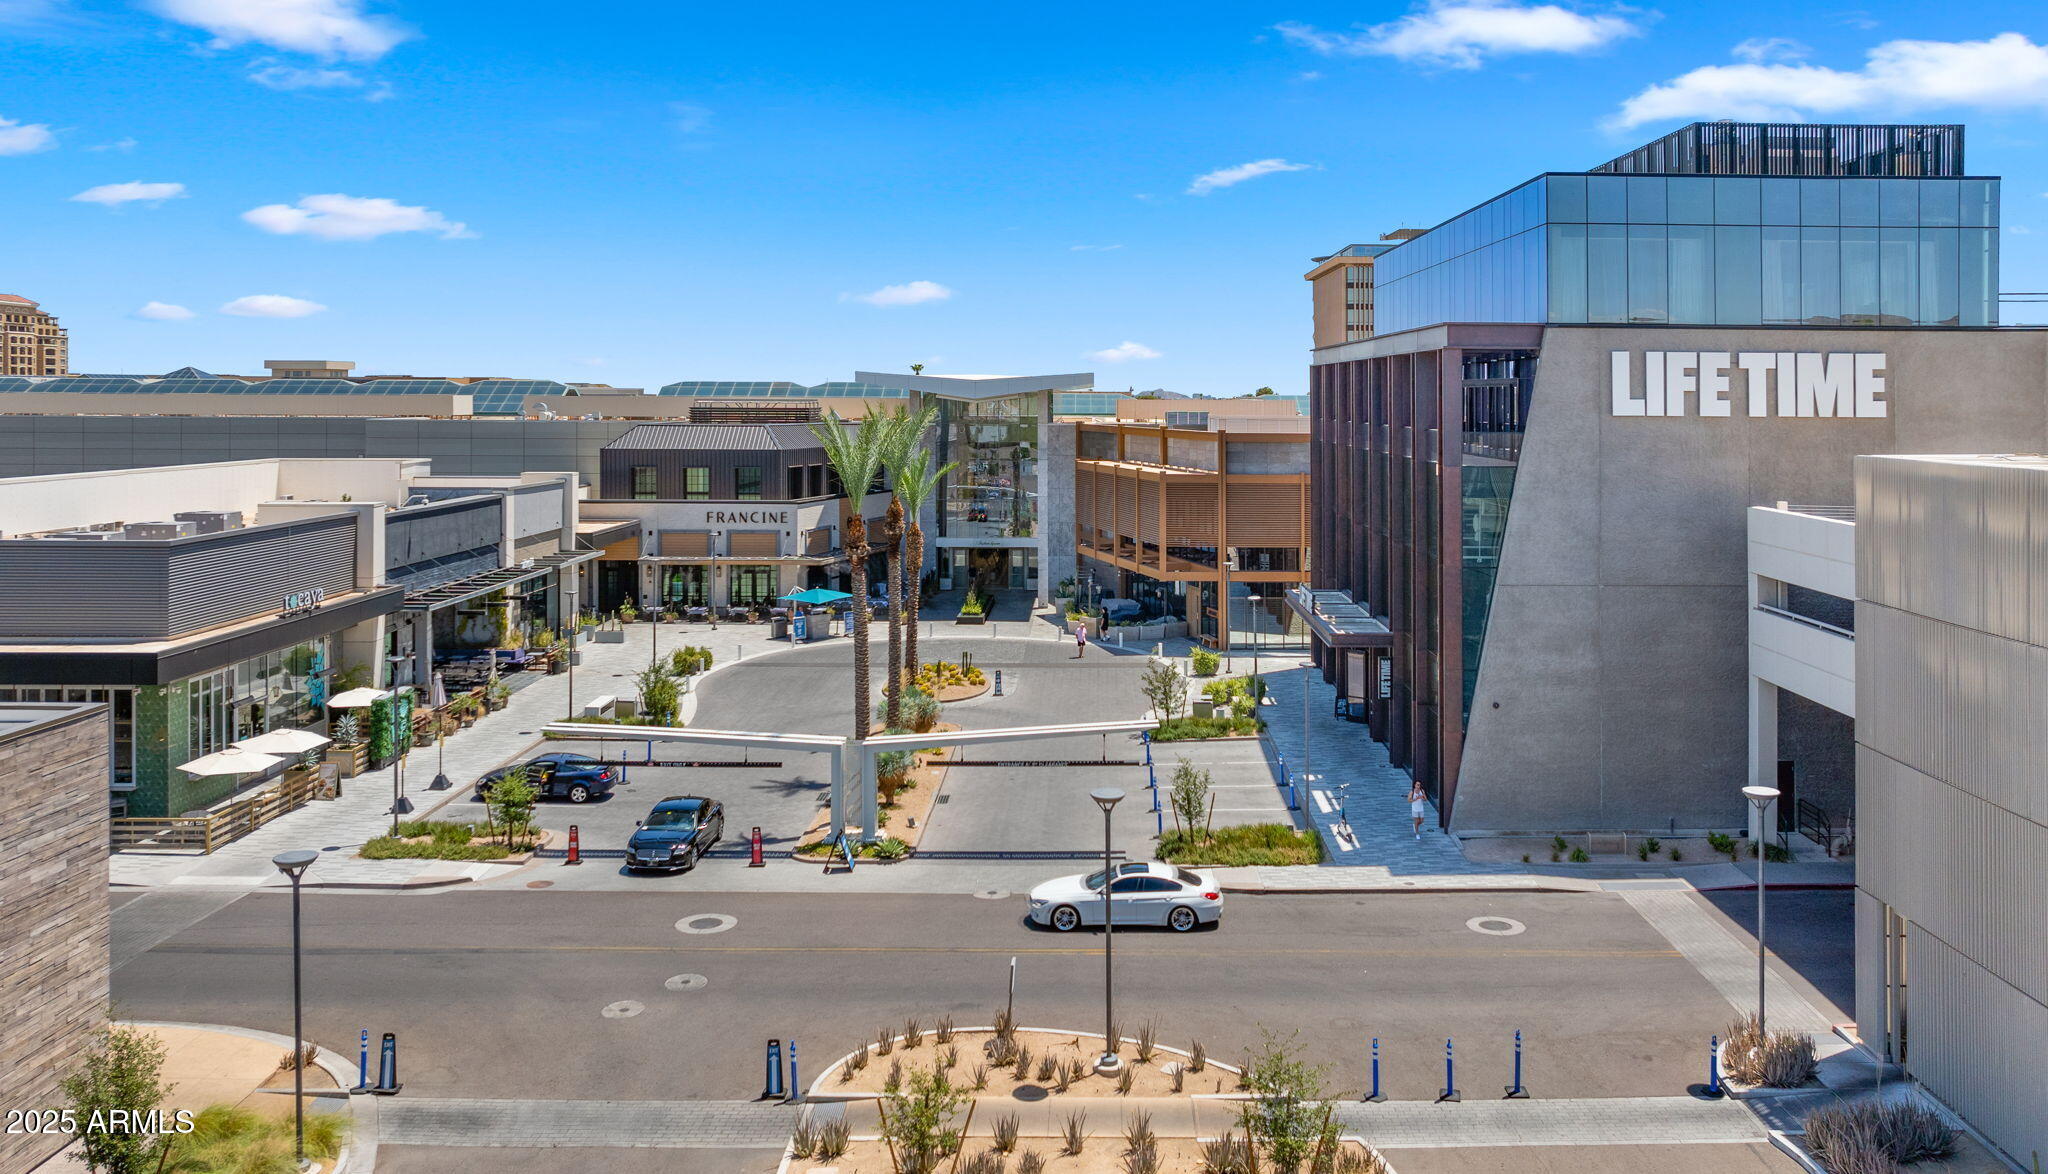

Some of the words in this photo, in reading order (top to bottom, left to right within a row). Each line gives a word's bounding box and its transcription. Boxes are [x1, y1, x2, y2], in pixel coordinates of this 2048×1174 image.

[1611, 351, 1731, 416] LIFE
[1738, 352, 1887, 417] TIME
[706, 511, 789, 524] FRANCINE
